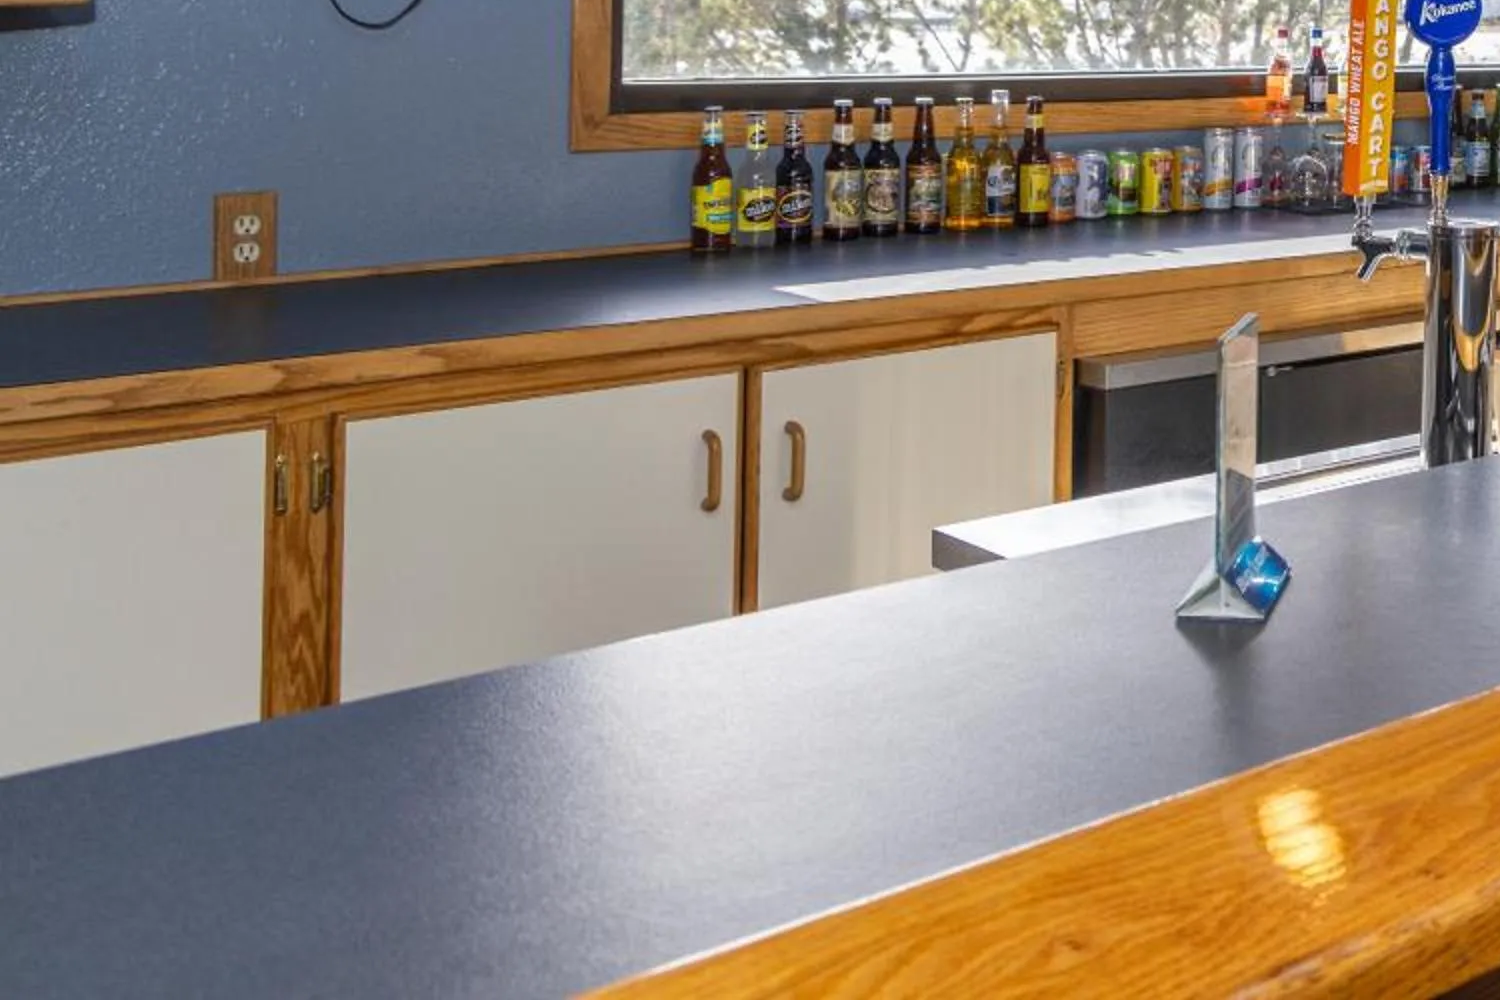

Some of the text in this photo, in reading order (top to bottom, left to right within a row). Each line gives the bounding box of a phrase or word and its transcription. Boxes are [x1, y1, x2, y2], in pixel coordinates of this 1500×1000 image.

[1347, 18, 1365, 145] MANGO WHEAT ALE
[1368, 91, 1386, 178] CART
